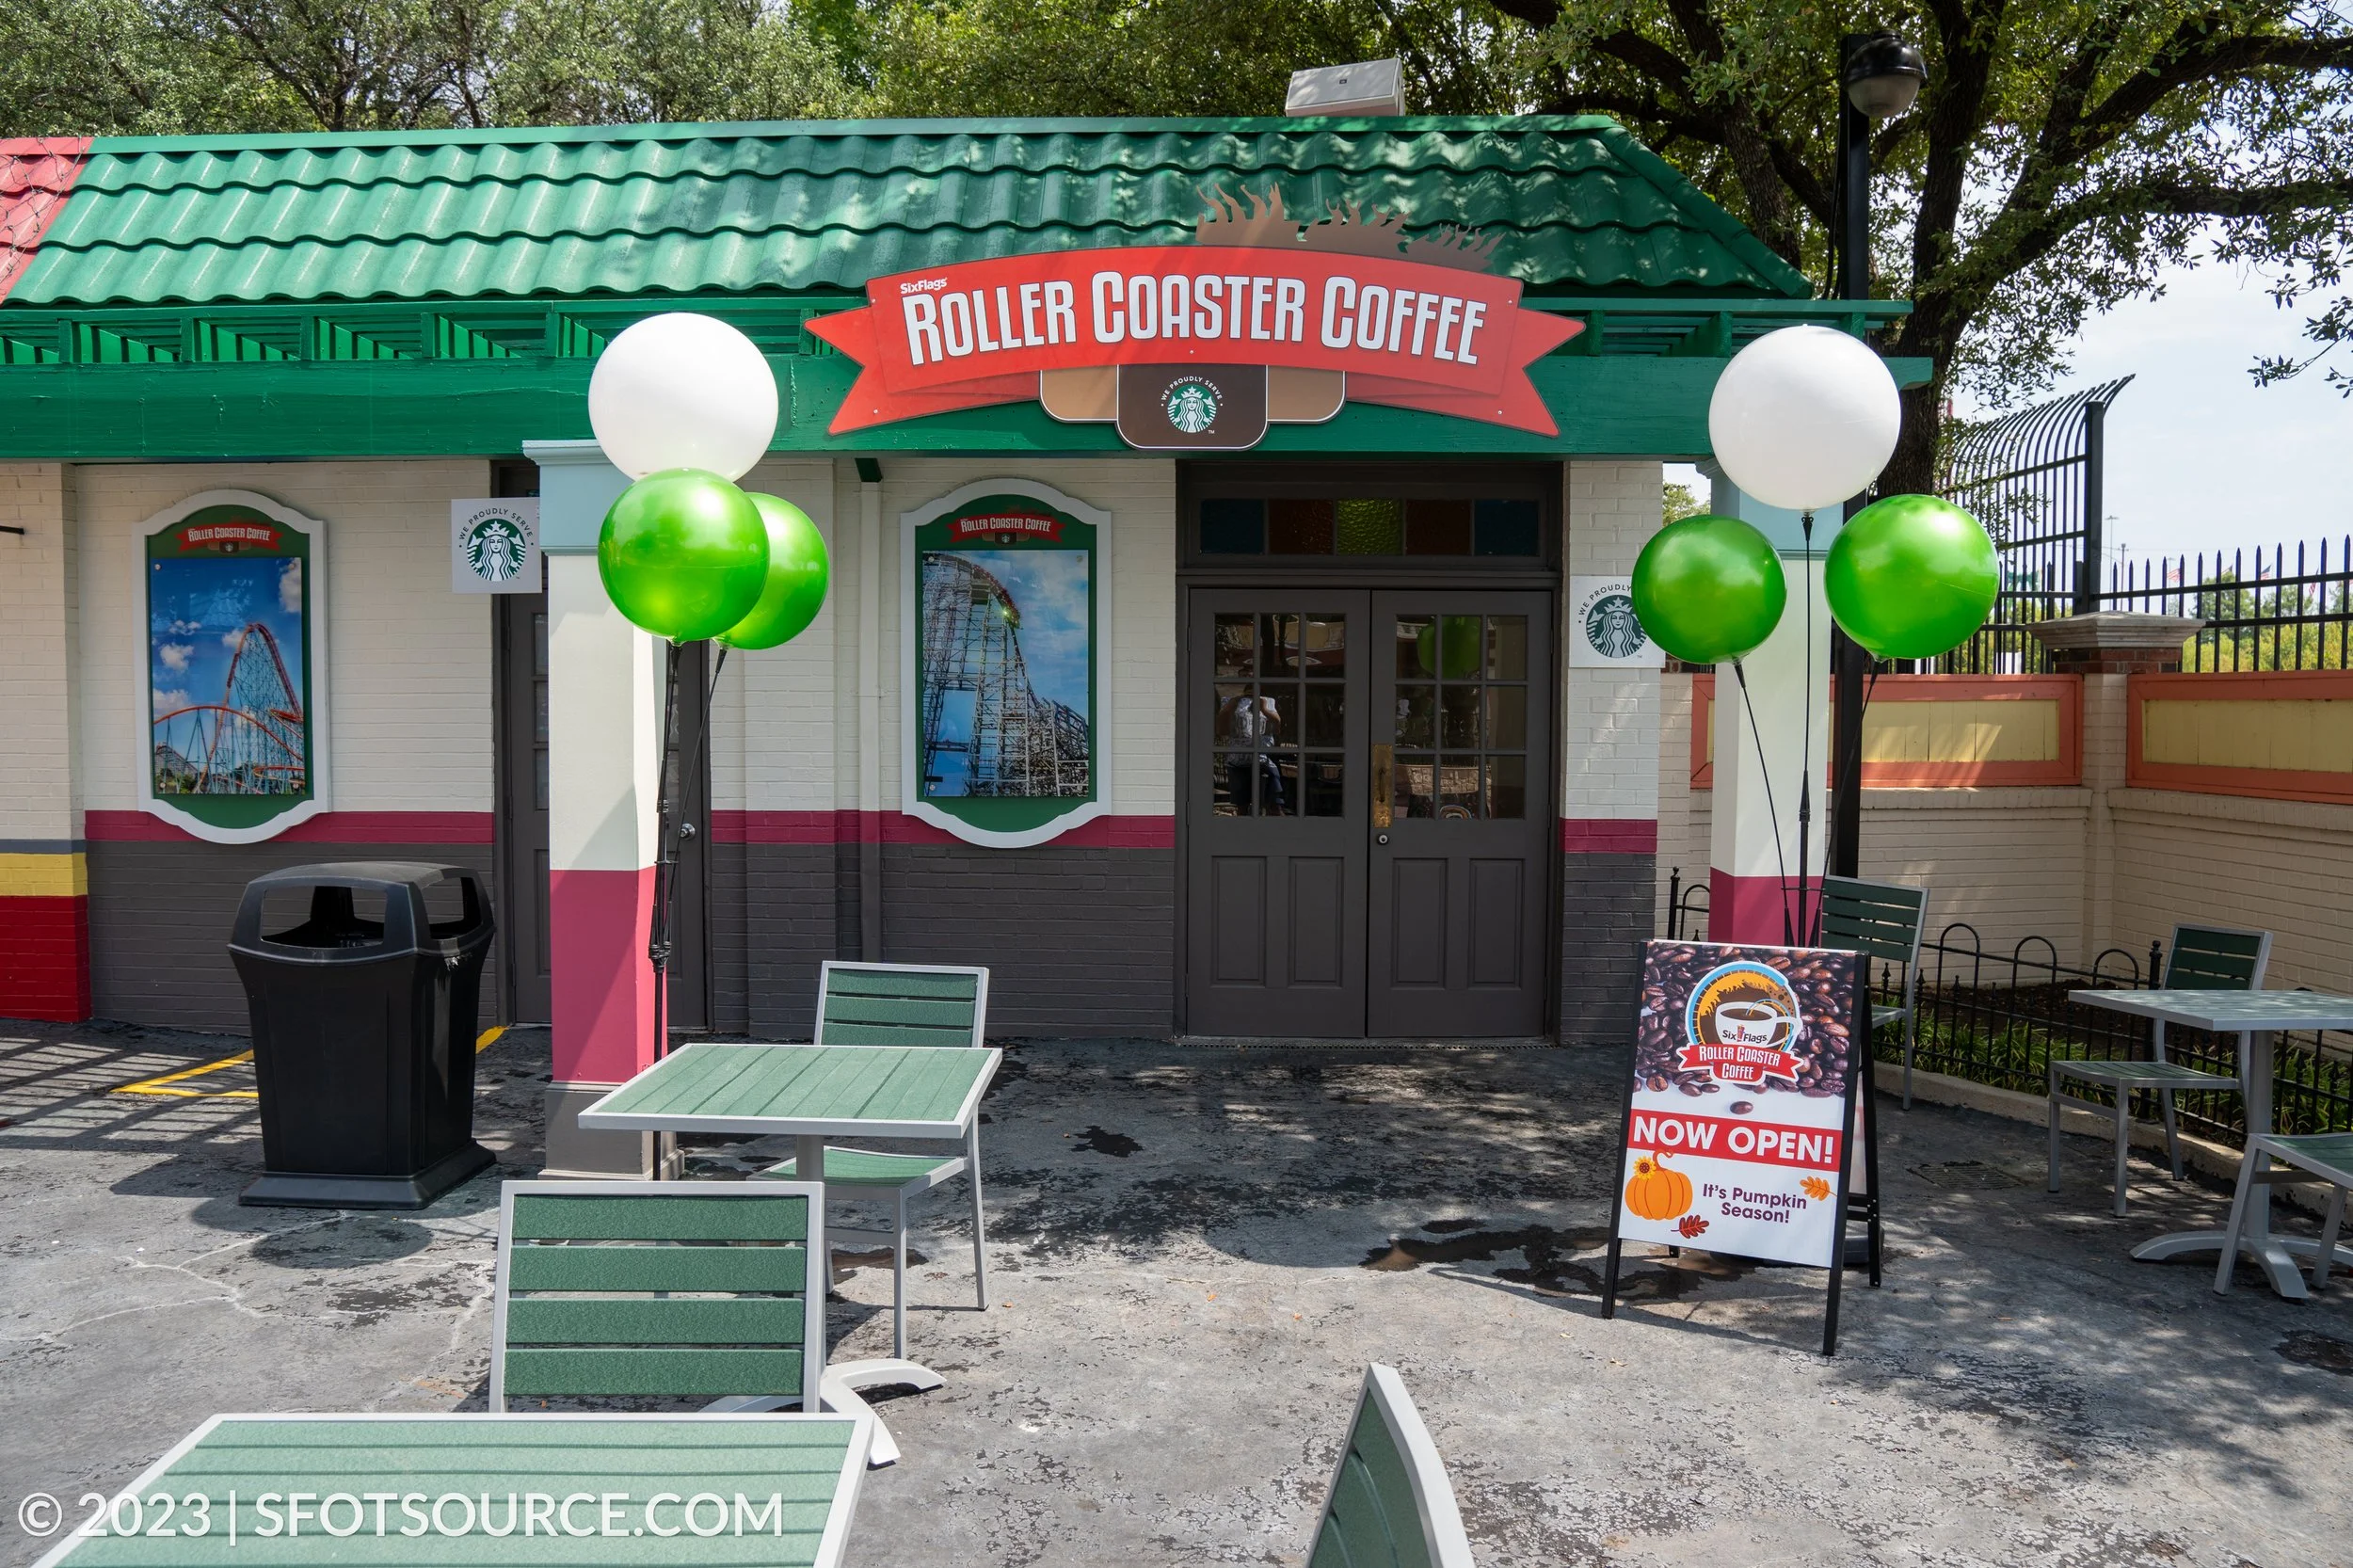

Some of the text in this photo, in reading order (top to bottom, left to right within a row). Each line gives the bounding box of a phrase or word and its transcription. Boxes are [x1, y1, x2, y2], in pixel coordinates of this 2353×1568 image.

[901, 278, 948, 295] SixFlags
[902, 271, 1487, 365] ROLLER COASTER COFFEE
[1160, 376, 1223, 401] WE PROUDLY SERVE
[188, 527, 271, 542] ROLLER COASTER COFFEE
[458, 508, 534, 540] WE PROUDLY SERVE
[961, 518, 1050, 532] ROLLER COASTER COFFEE
[1579, 602, 1589, 616] WE
[1722, 1030, 1768, 1044] Six Flags
[1699, 1046, 1781, 1067] ROLLER COASTER
[1721, 1063, 1754, 1080] COFFEE
[1632, 1115, 1834, 1164] NOW OPEN!
[1732, 1187, 1807, 1209] Pumpkin
[1721, 1202, 1790, 1224] Season!
